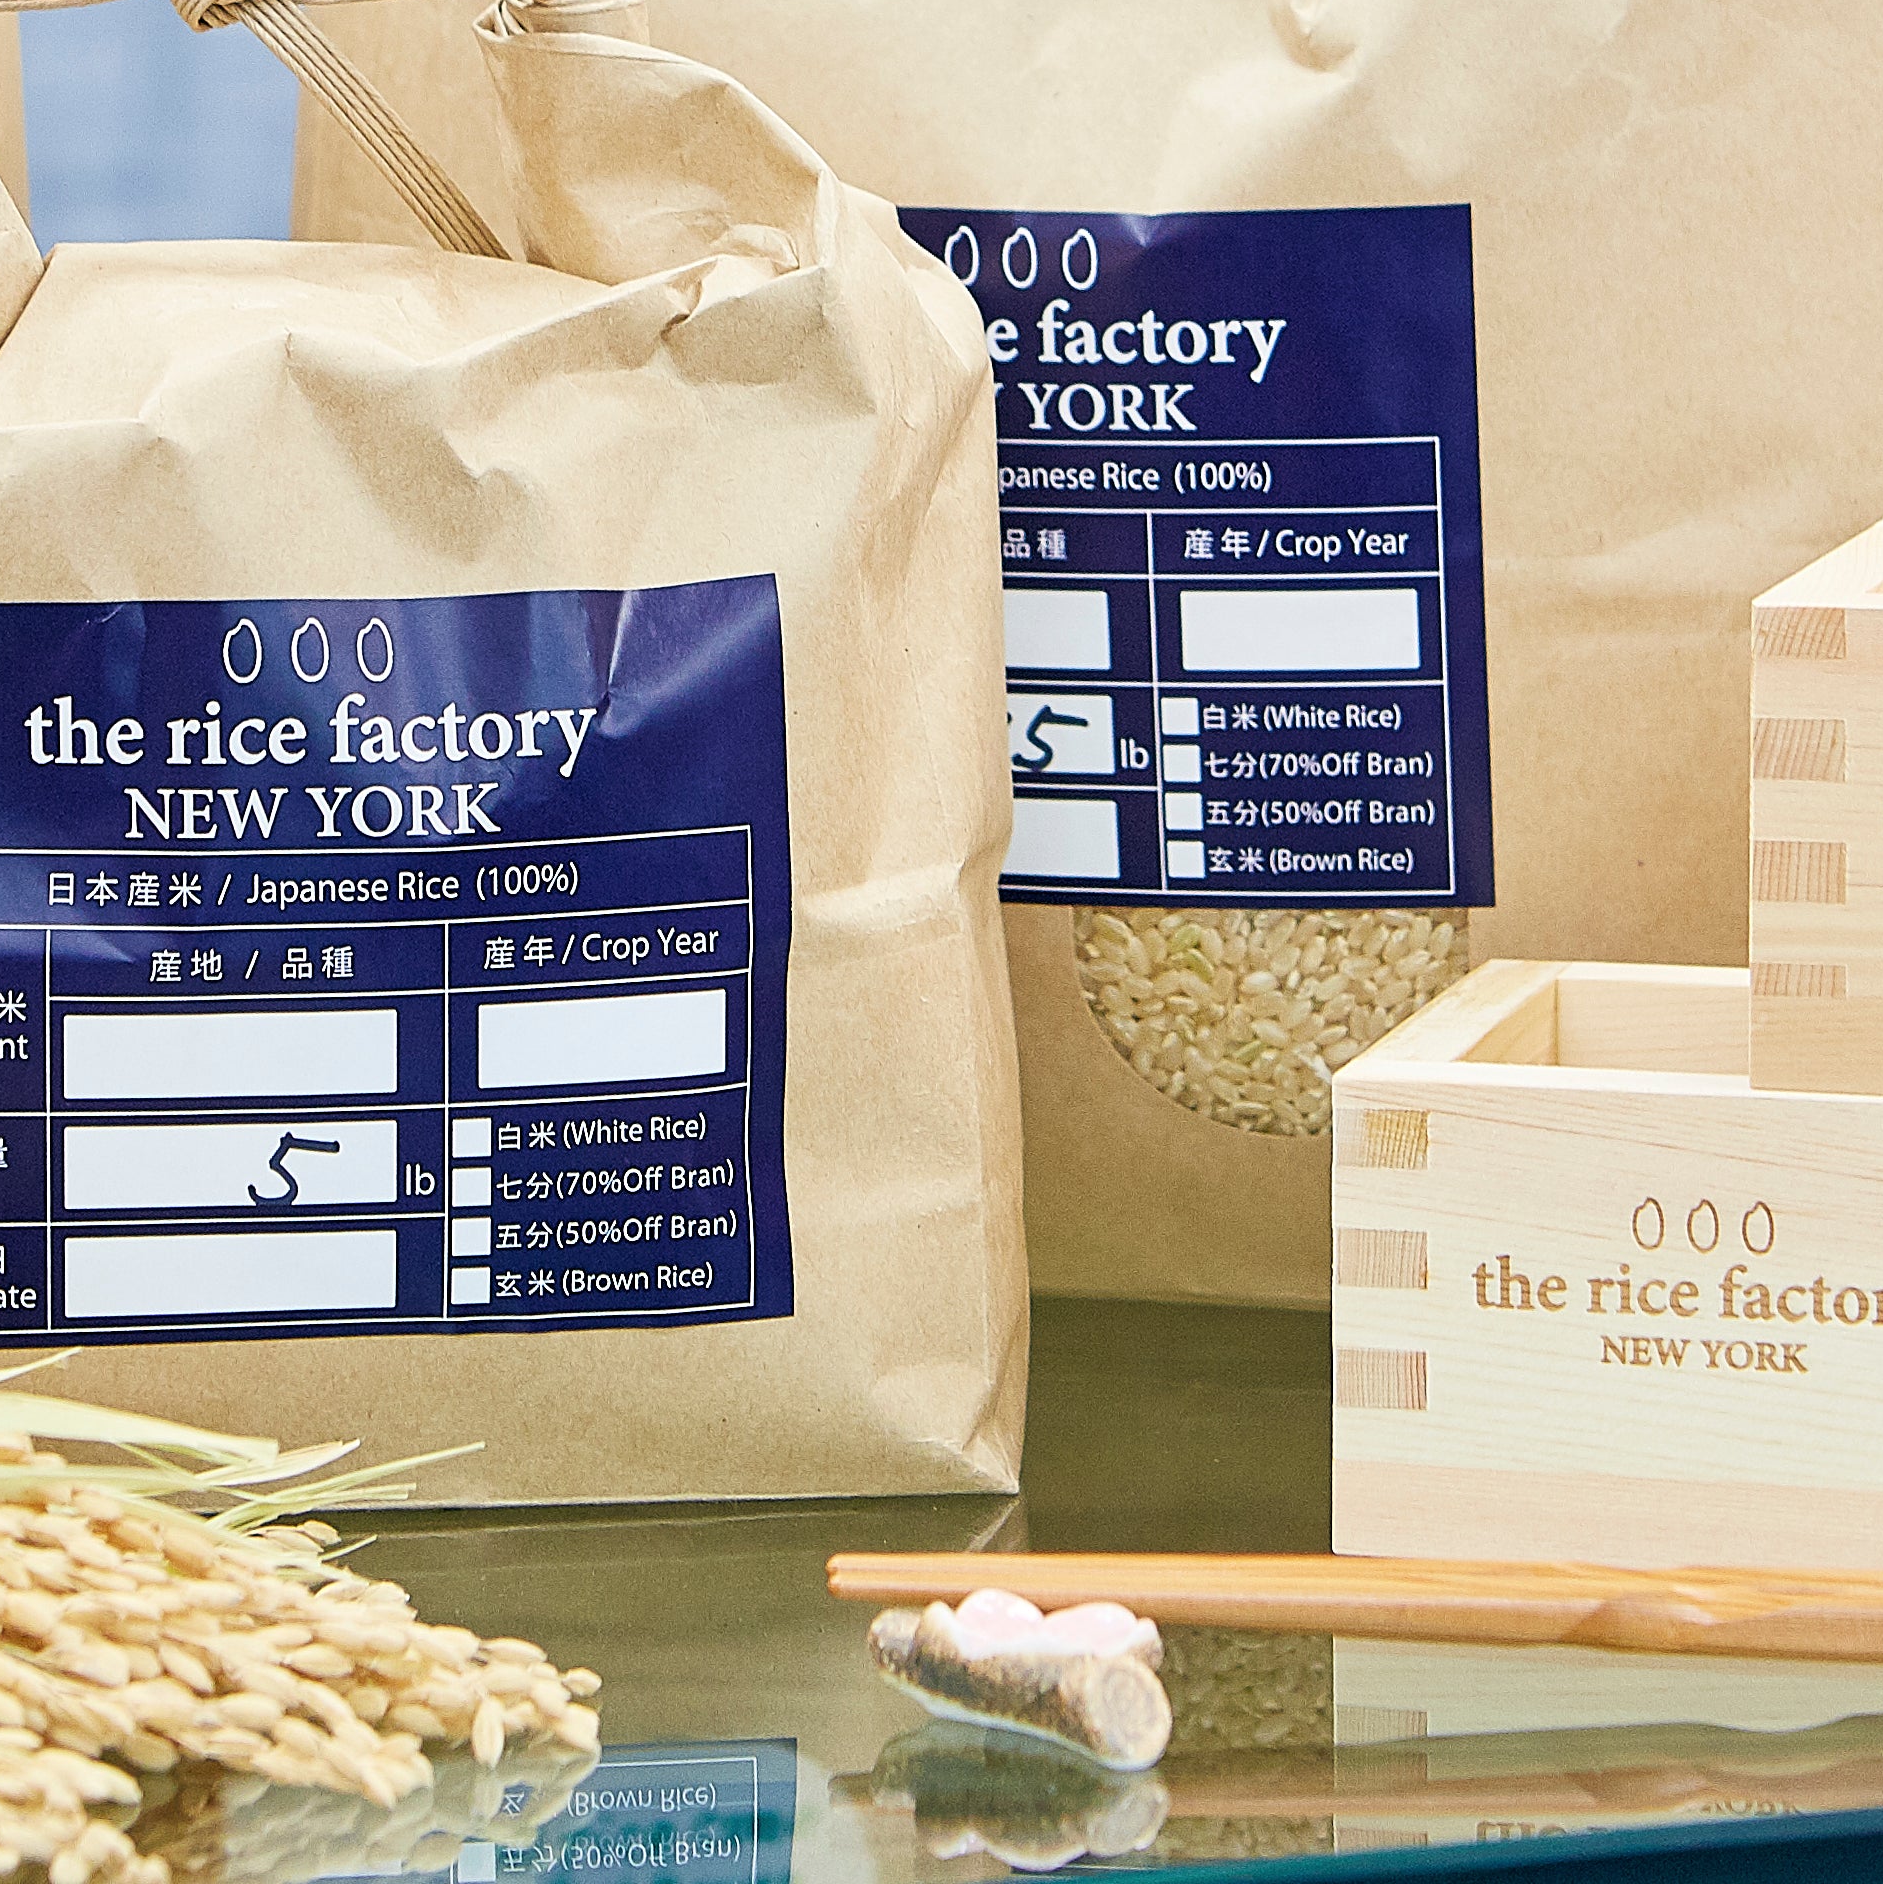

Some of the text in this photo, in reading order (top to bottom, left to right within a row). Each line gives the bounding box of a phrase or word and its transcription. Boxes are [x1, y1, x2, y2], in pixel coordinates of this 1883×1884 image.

[1036, 298, 1287, 384] factory
[1017, 382, 1198, 432] YORK
[998, 462, 1271, 494] panese Rice (100%)
[1002, 528, 1067, 560] 品種
[1184, 527, 1252, 560] 産年
[1275, 528, 1342, 562] Crop
[1346, 528, 1409, 558] Year
[24, 692, 597, 777] the rice factory
[1203, 703, 1402, 732] 白米 (White Rice)
[1007, 704, 1088, 772] 5
[1120, 738, 1150, 769] lb
[1368, 751, 1434, 778] Bran)
[124, 781, 501, 840] NEW YORK
[1369, 799, 1436, 827] Bran)
[1208, 847, 1415, 876] 玄米 (Brown Rice)
[48, 872, 203, 908] 日本産米
[246, 873, 388, 910] Japanese
[397, 871, 459, 900] Rice
[476, 862, 579, 900] (100%)
[149, 949, 223, 982] 産地
[281, 946, 355, 980] 品種
[484, 936, 555, 969] 産年
[582, 933, 649, 964] Crop
[657, 927, 719, 956] Year
[497, 1113, 707, 1151] 白米 (White Rice)
[247, 1132, 340, 1207] 5
[405, 1164, 436, 1197] lb
[671, 1159, 734, 1191] Bran)
[670, 1210, 738, 1240] Bran)
[496, 1262, 713, 1298] 玄米 (Brown Rice)
[1472, 1255, 1568, 1312] the
[1586, 1263, 1699, 1317] rice
[1600, 1335, 1808, 1373] NEW YORK
